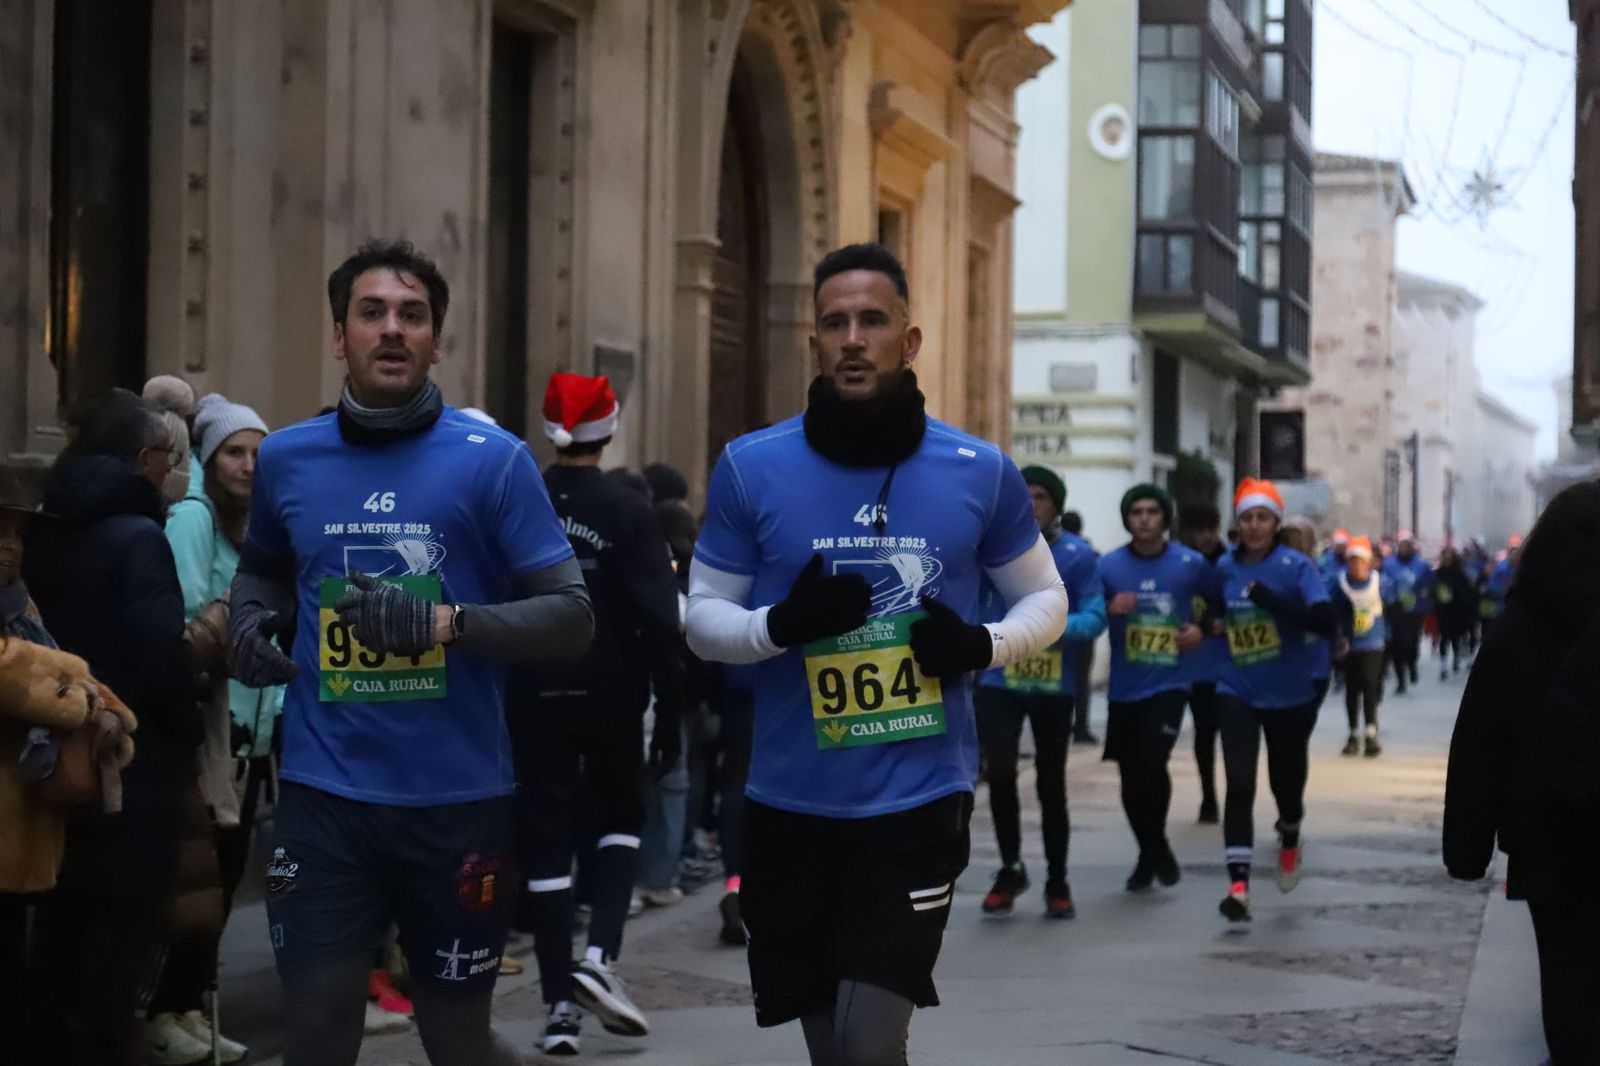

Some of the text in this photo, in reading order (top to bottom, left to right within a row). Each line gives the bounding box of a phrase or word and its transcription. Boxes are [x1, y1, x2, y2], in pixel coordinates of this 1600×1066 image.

[363, 491, 396, 513] 46
[853, 504, 888, 526] 46
[324, 523, 432, 535] SAN SILVESTRE 2025
[812, 536, 927, 550] SAN SILVESTRE 2025
[837, 630, 897, 647] CAJA RURAL
[1129, 628, 1171, 651] 672
[353, 677, 439, 693] CAJA RURAL
[817, 657, 922, 715] 964
[850, 713, 938, 736] CAJA RURAL
